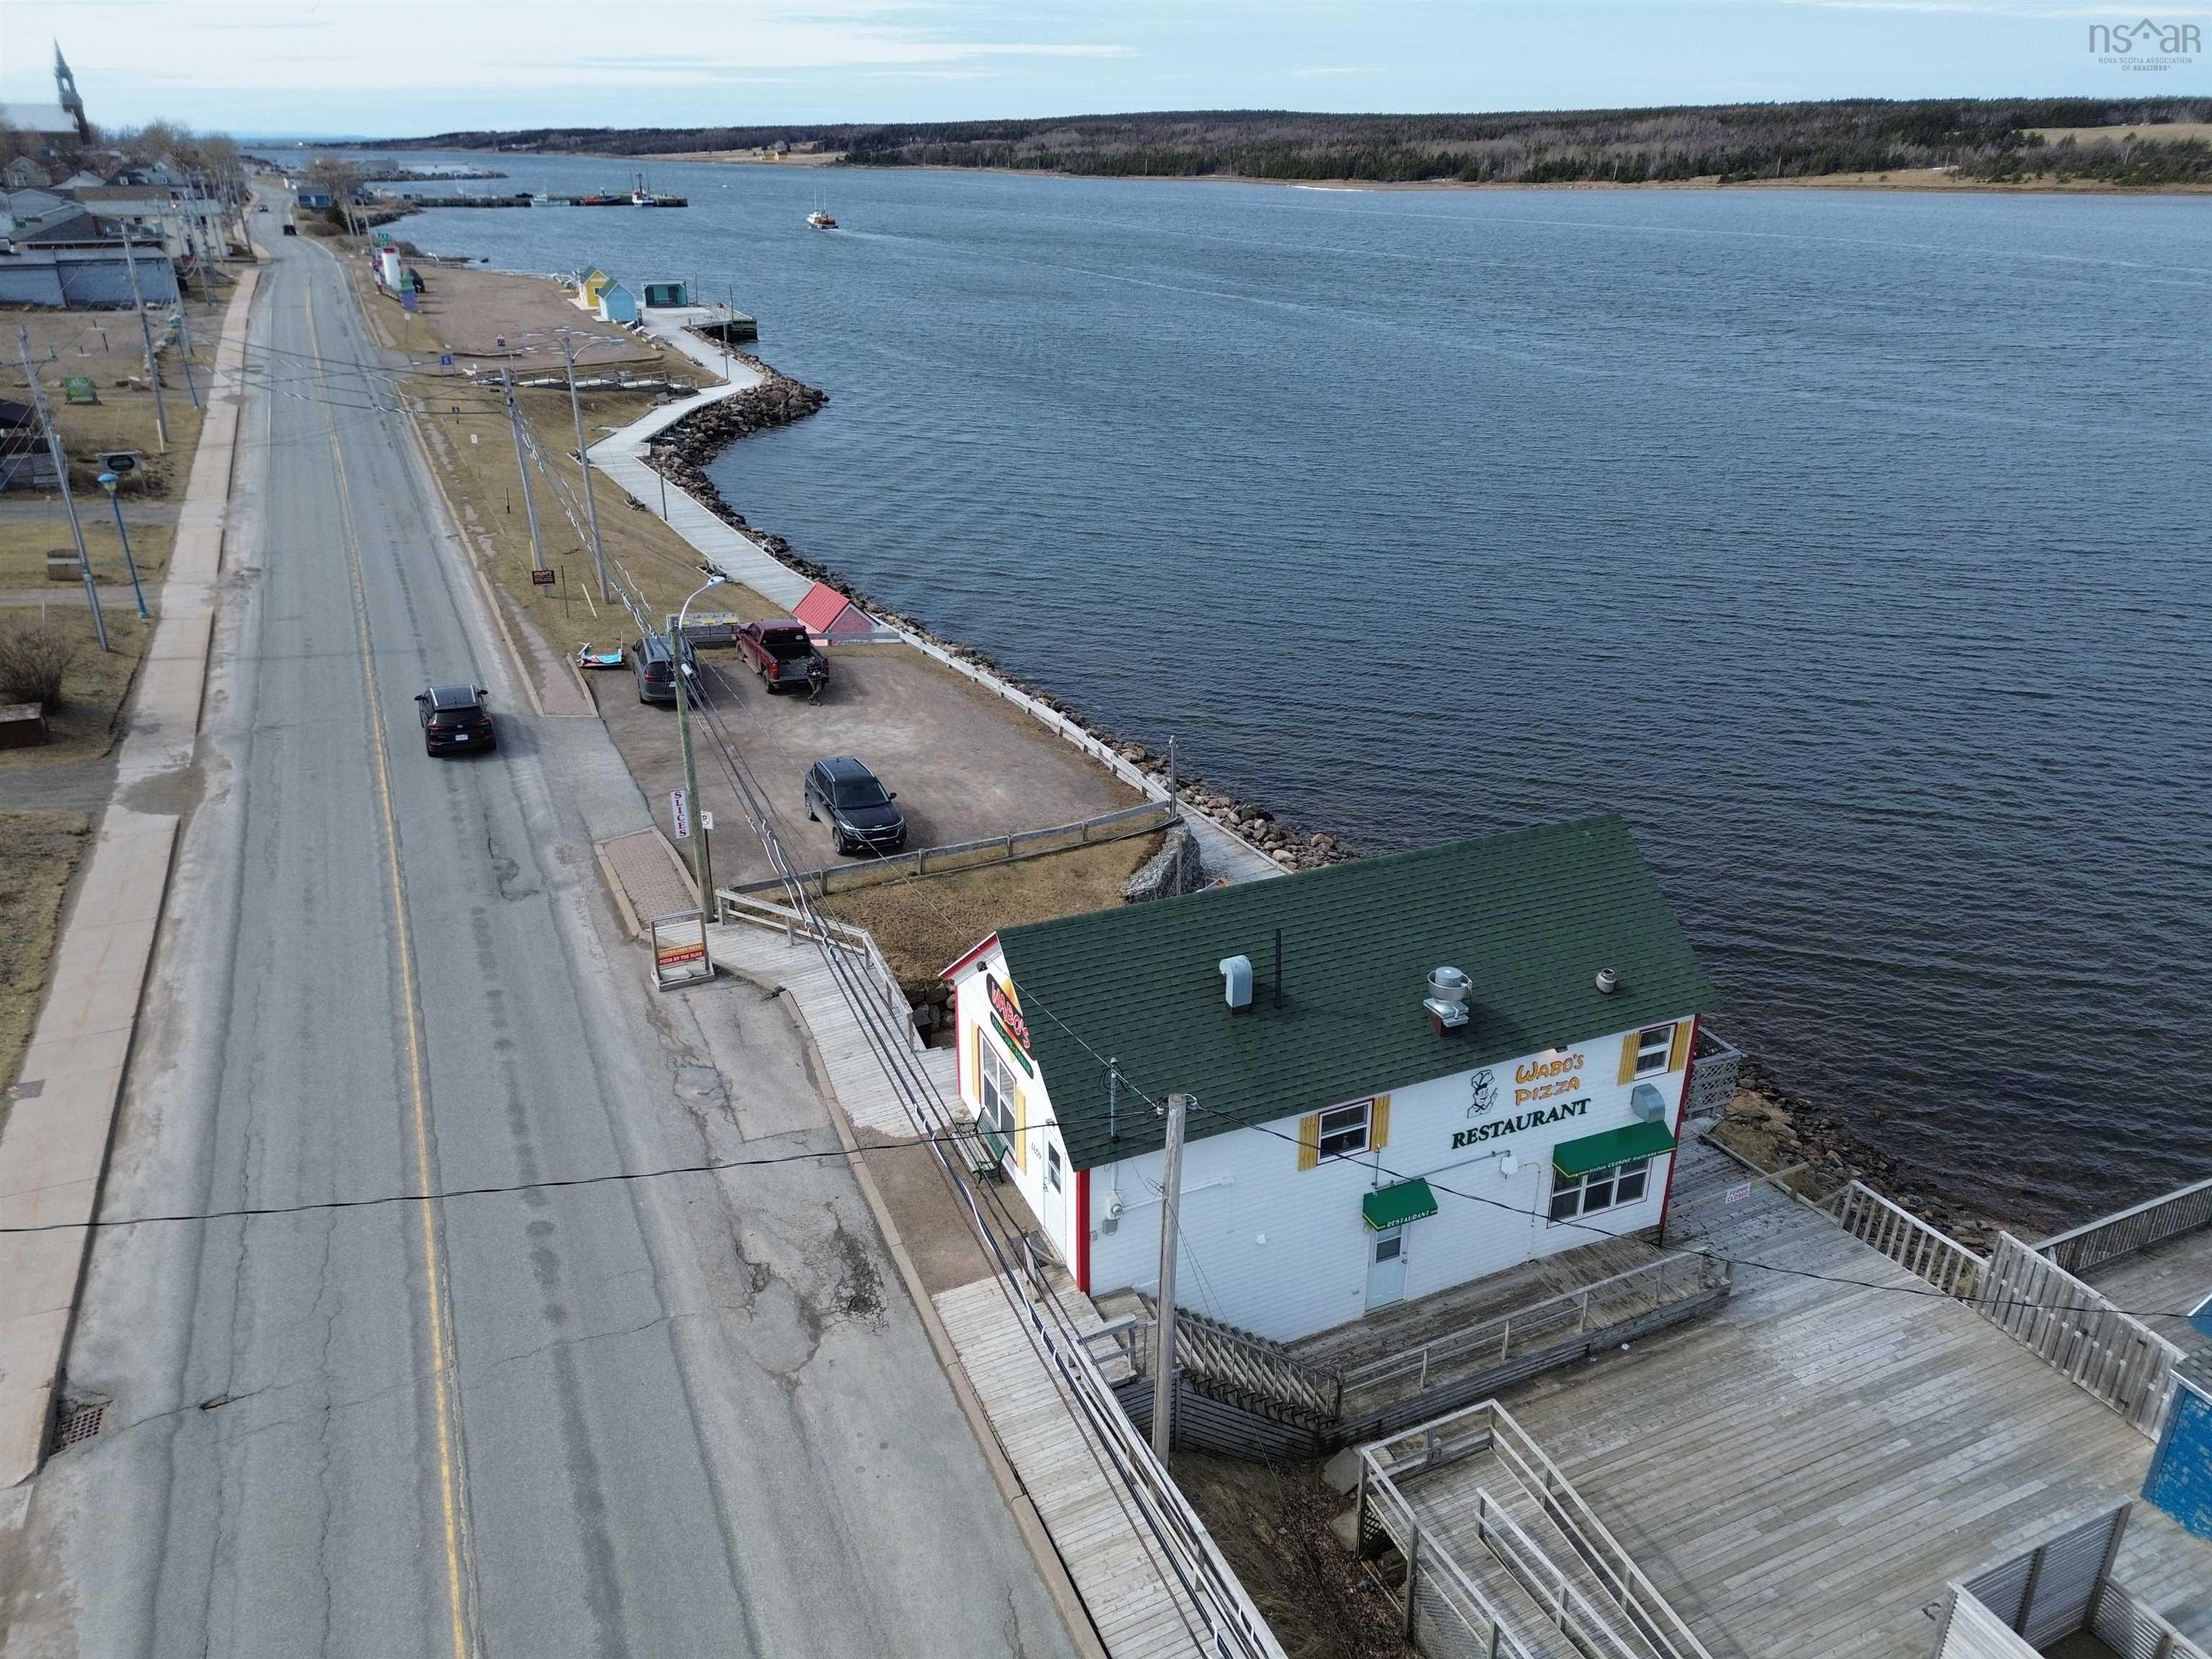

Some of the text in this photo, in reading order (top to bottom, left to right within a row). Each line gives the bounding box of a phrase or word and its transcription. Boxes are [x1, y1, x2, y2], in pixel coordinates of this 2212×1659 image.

[674, 791, 687, 837] SLICES
[992, 981, 1030, 1049] WABO'S
[1516, 1053, 1584, 1084] WABO'S
[1514, 1076, 1580, 1107] PIZZA
[1451, 1097, 1591, 1150] RESTAURANT
[1607, 1157, 1632, 1168] CUISINE
[1386, 1210, 1430, 1228] RESTAURANT
